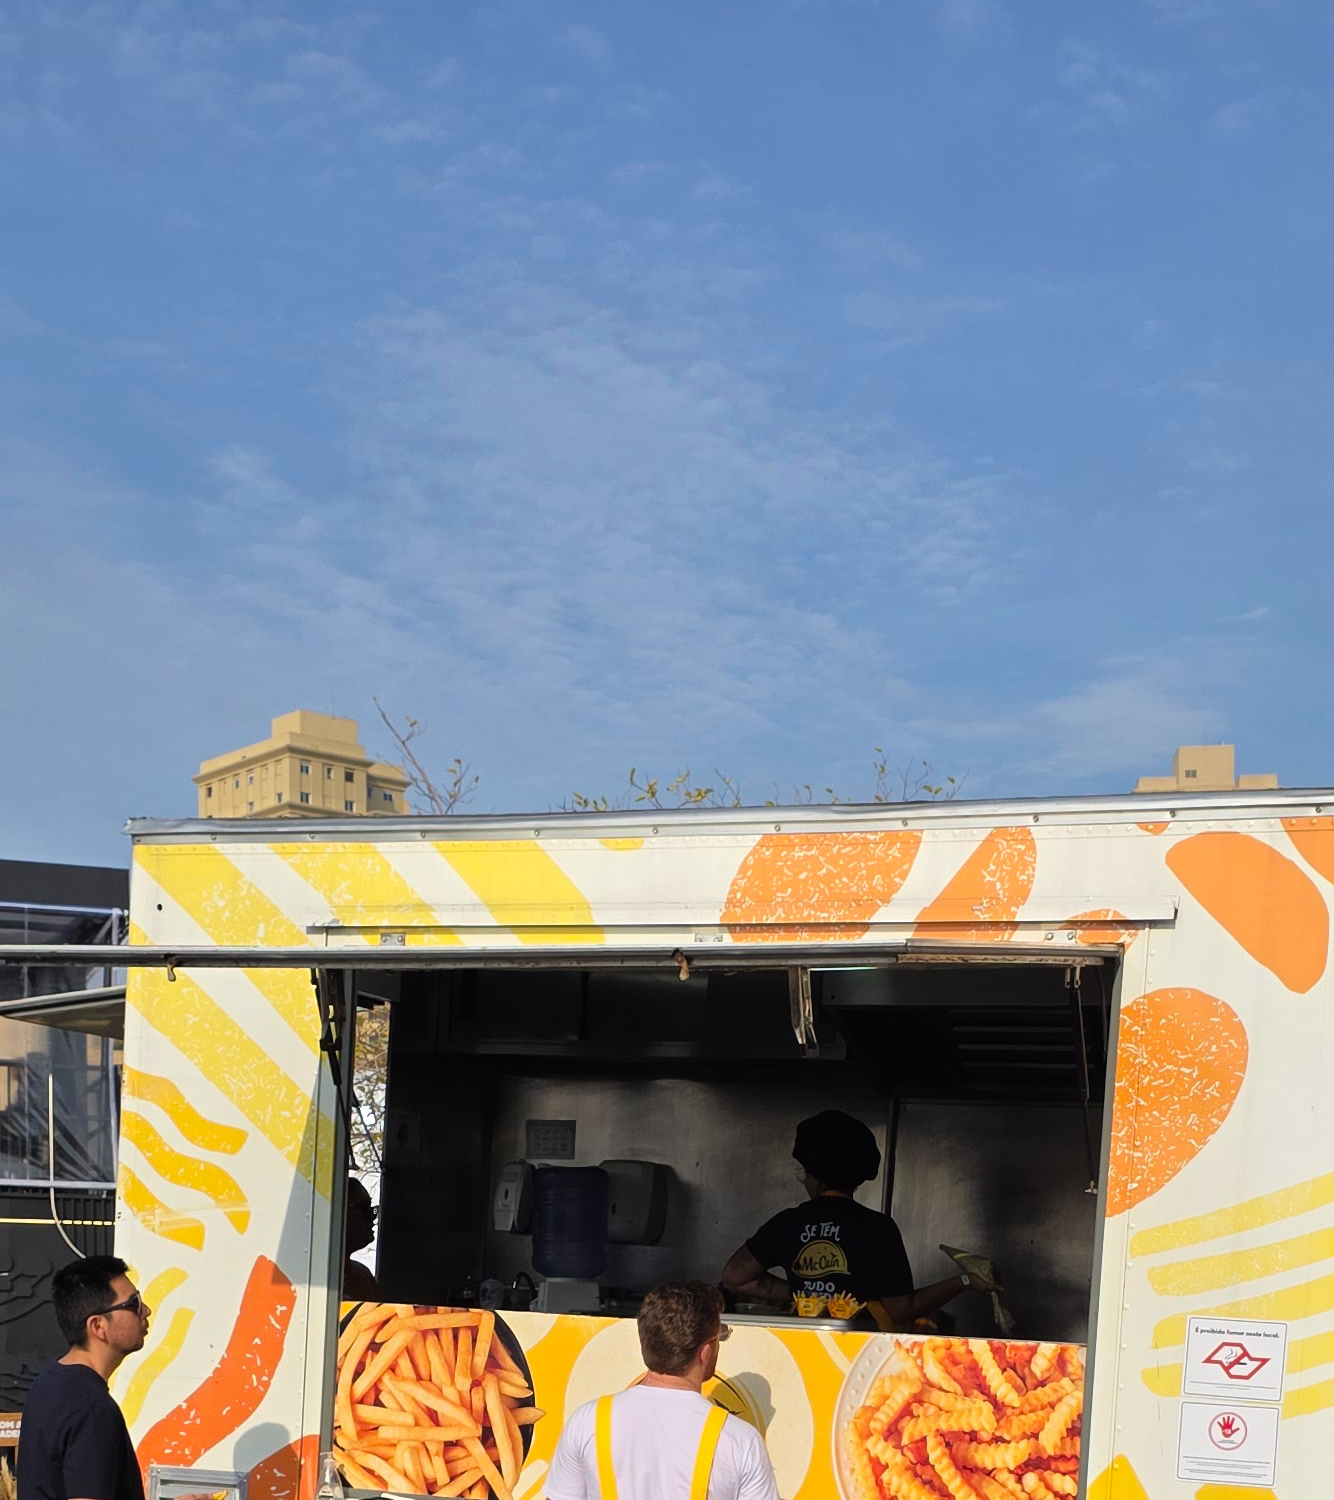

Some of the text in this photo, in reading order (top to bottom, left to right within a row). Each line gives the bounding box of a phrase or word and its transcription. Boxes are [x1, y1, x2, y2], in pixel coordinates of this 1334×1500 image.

[800, 1221, 841, 1243] SE TEM
[801, 1255, 840, 1272] McCain
[803, 1281, 836, 1293] TUDO
[1200, 1327, 1226, 1335] proibido
